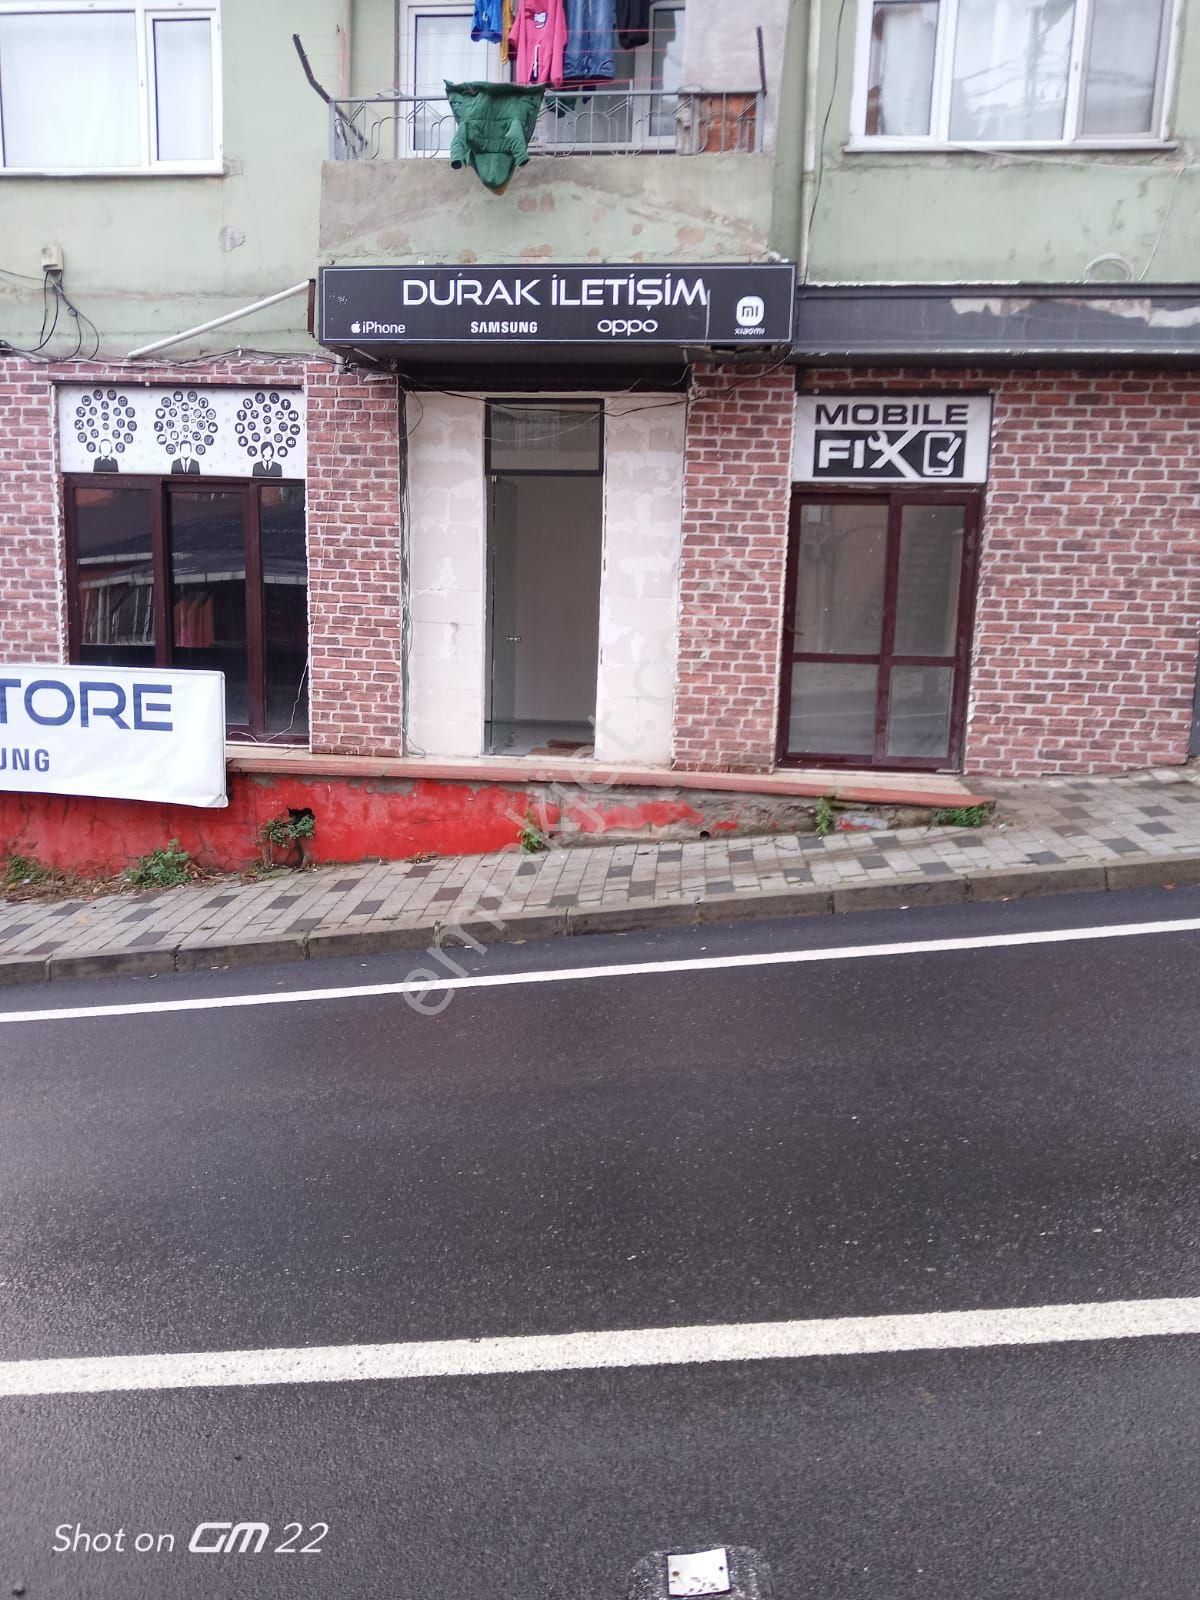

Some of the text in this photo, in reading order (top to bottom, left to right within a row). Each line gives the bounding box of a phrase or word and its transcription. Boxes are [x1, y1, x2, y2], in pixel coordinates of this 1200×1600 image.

[403, 272, 708, 312] DURAK İLETİŞİM
[362, 320, 406, 334] iPhone
[470, 320, 538, 334] SAMSUNG
[815, 403, 970, 426] MOBILE
[818, 429, 921, 479] FIX
